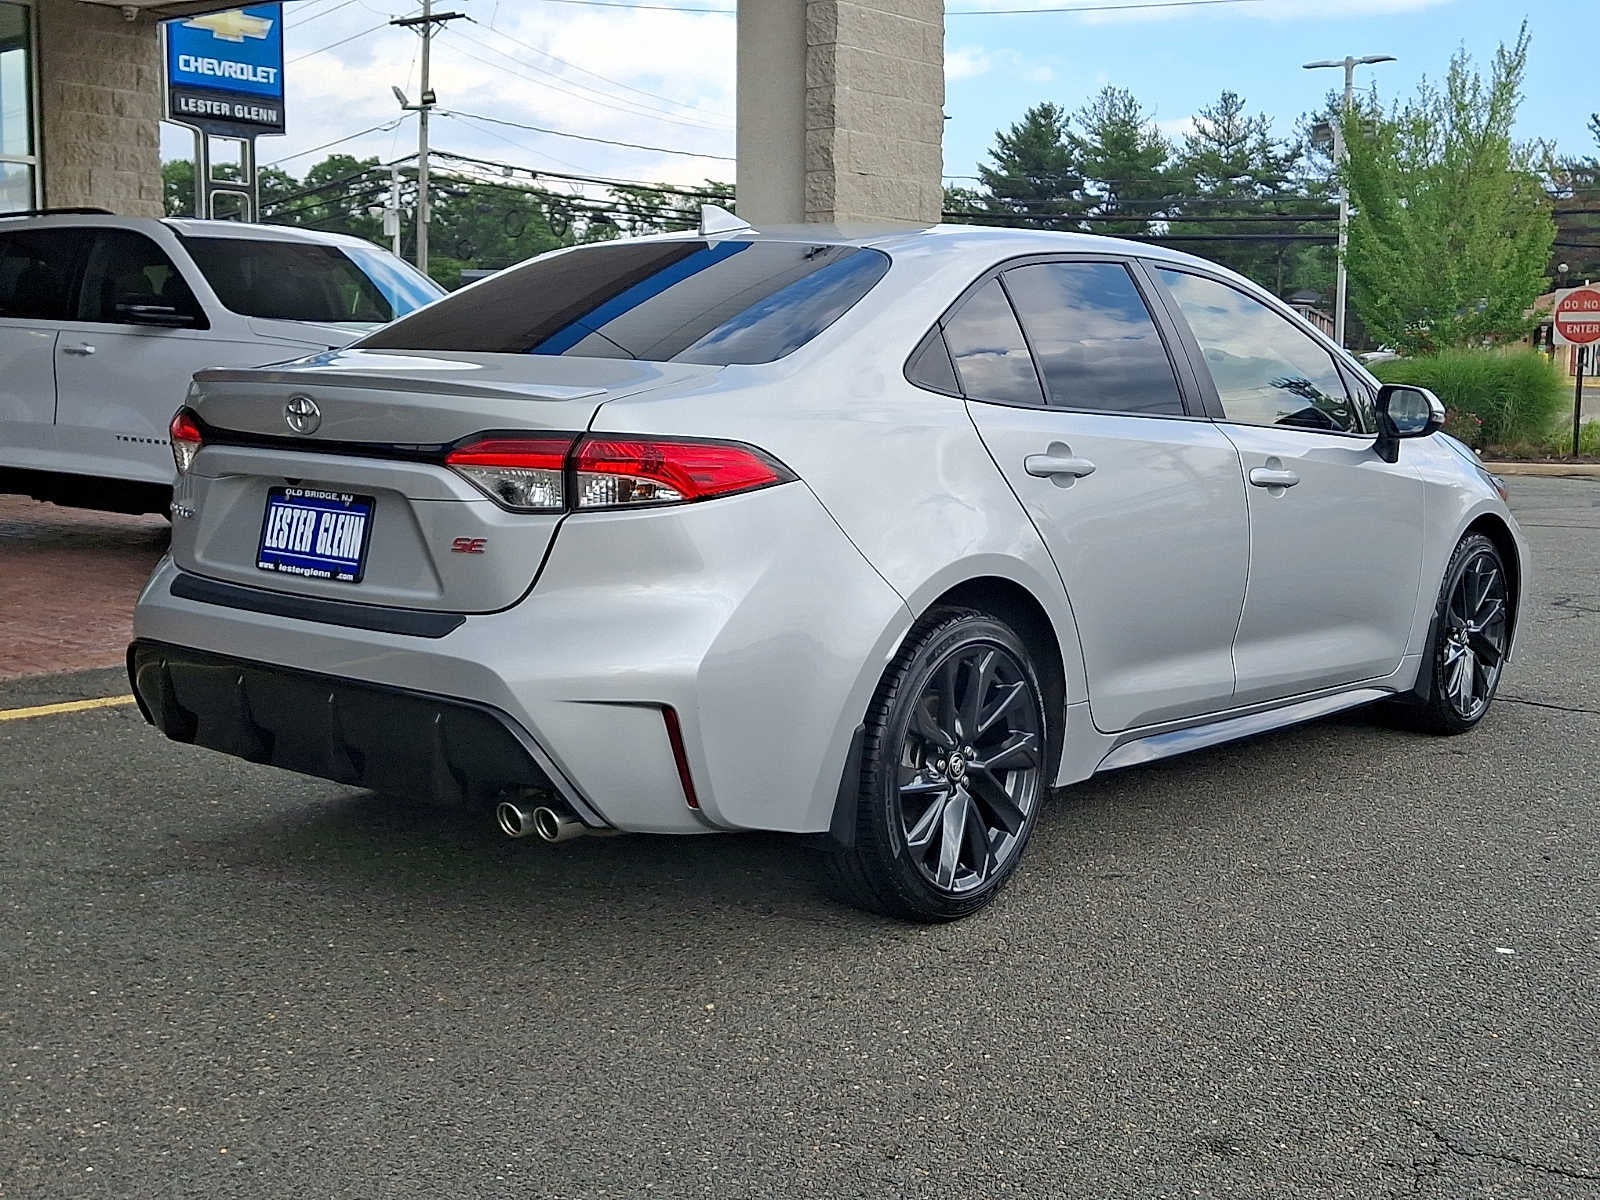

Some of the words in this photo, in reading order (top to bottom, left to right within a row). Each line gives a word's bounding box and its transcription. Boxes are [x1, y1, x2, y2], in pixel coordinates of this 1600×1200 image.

[178, 54, 277, 84] CHEVROLET
[180, 98, 230, 116] LESTER
[234, 104, 277, 123] GLENN
[1564, 300, 1579, 309] DO
[1583, 300, 1599, 309] NO
[1567, 324, 1600, 334] ENTER
[115, 435, 168, 445] TRAVERS
[285, 488, 303, 497] OLD
[304, 490, 340, 501] BRIDGE,
[341, 494, 354, 502] NJ
[265, 506, 316, 552] LESTER
[316, 512, 365, 559] GLENN
[450, 536, 488, 554] SE
[278, 563, 331, 578] lesterglenn
